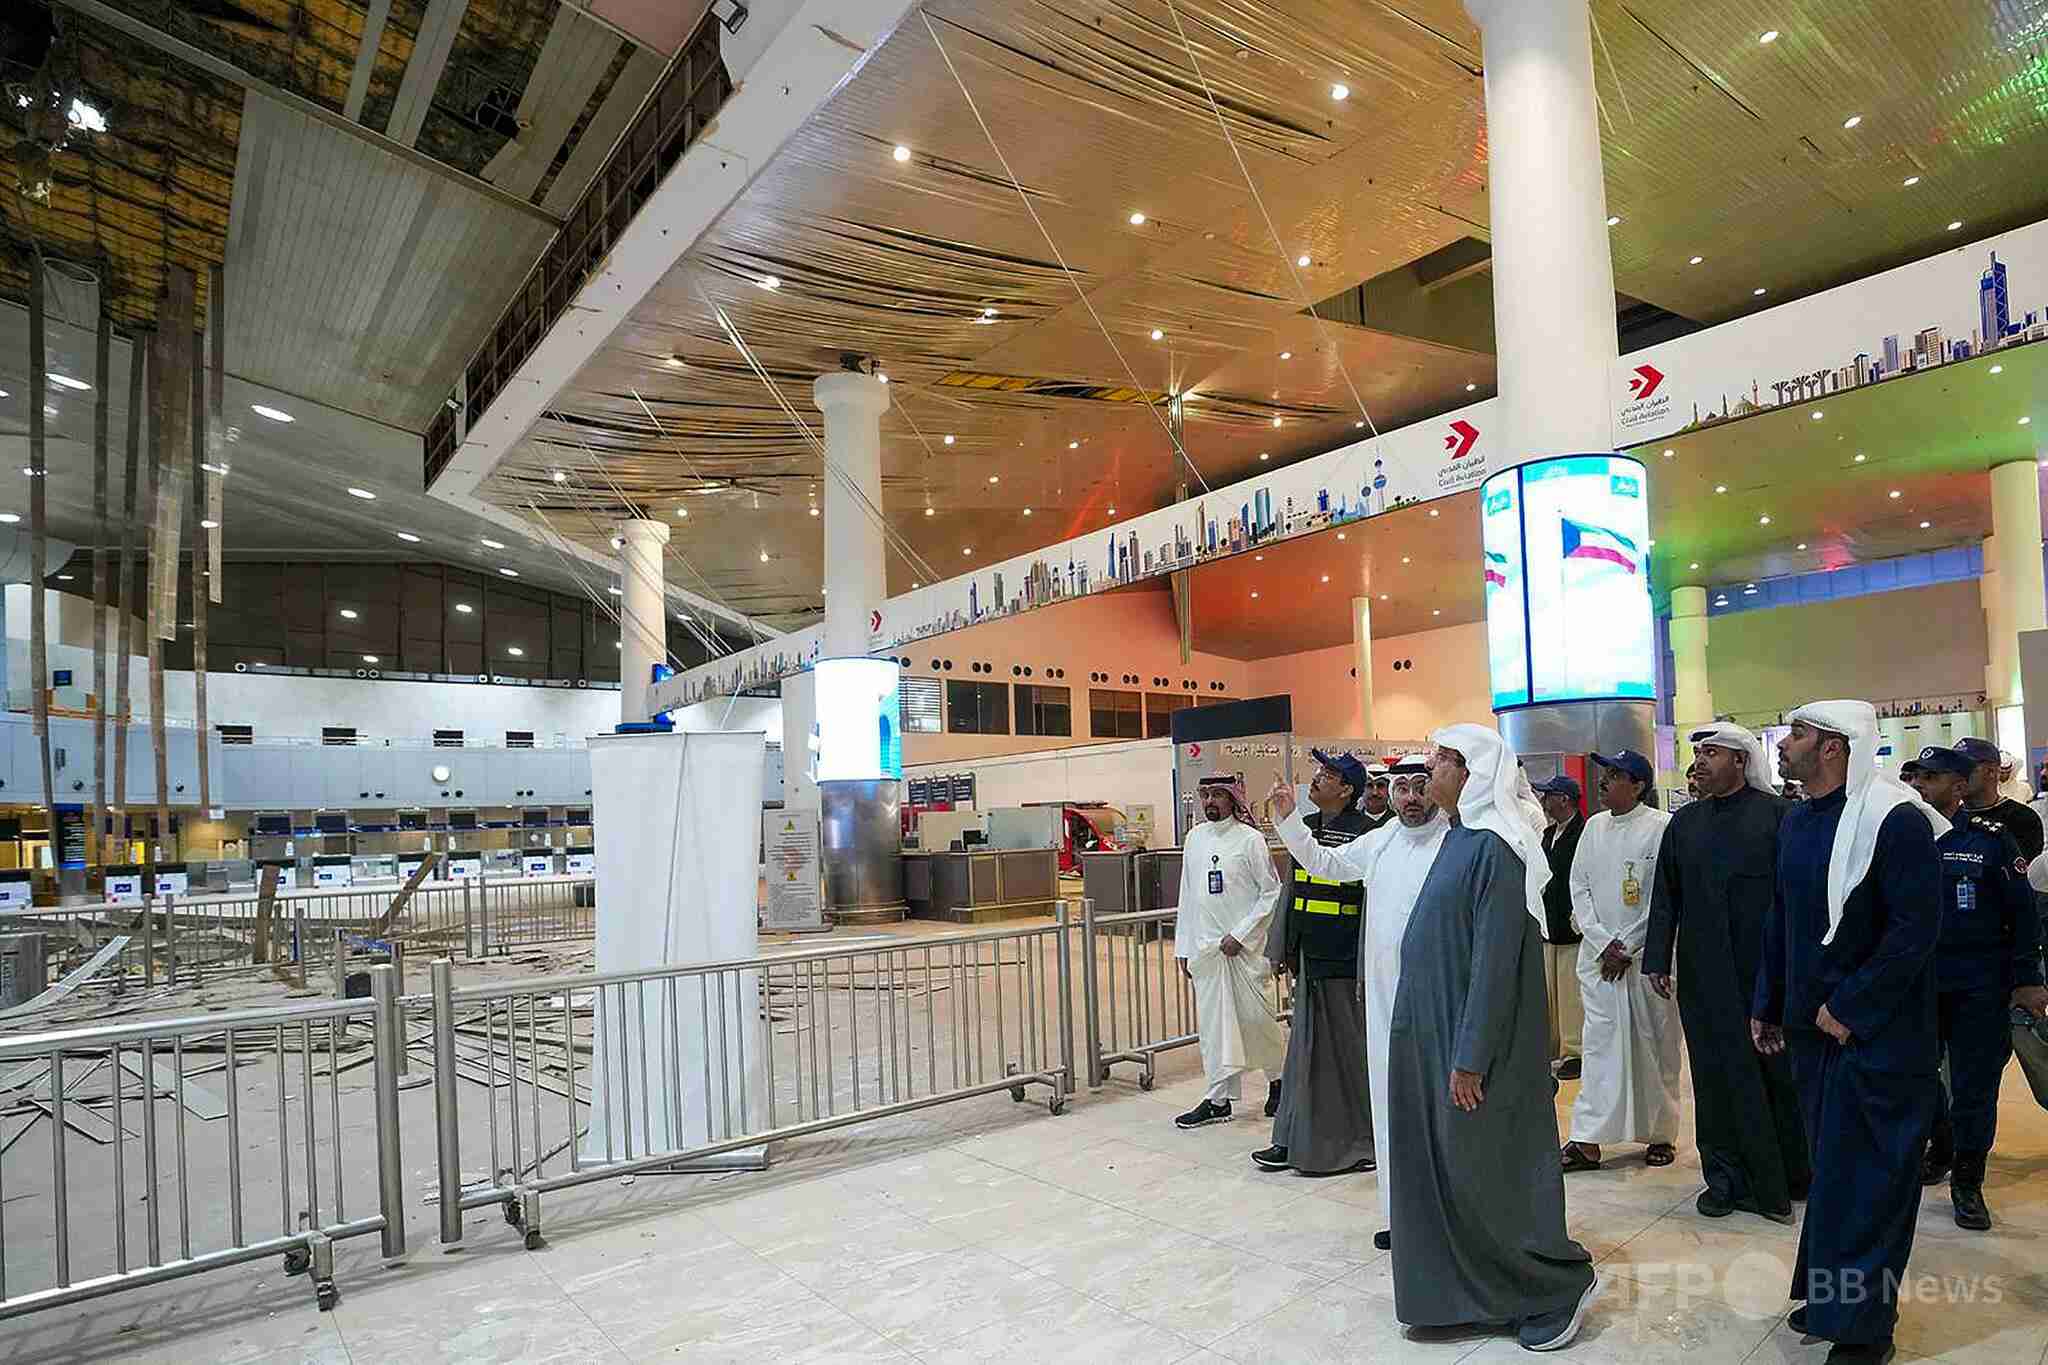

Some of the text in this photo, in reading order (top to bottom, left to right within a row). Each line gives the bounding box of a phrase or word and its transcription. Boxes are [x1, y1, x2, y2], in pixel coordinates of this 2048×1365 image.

[1620, 413, 1638, 426] Civil
[1638, 406, 1671, 420] Aviation
[1438, 474, 1456, 487] Civil
[1456, 468, 1487, 481] Aviation
